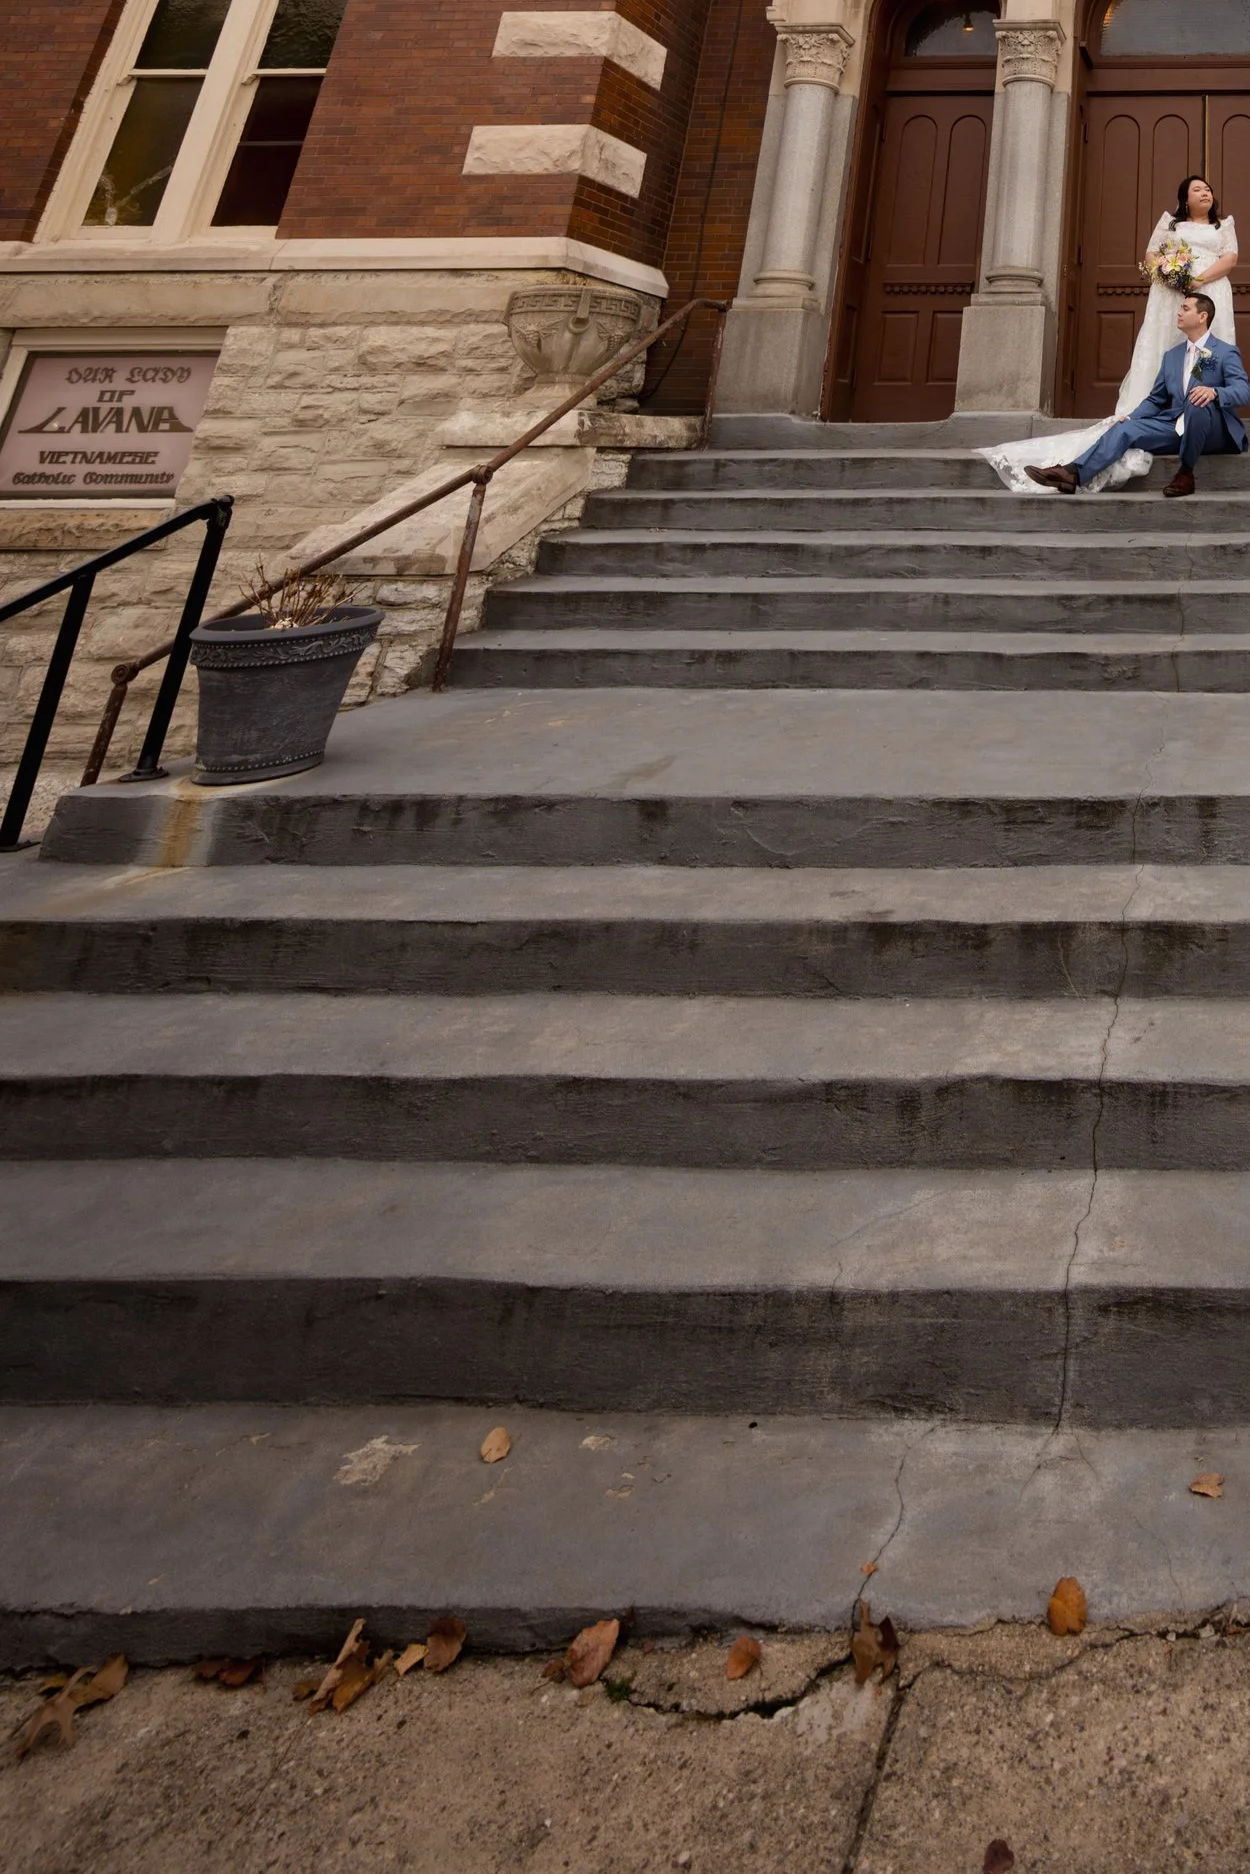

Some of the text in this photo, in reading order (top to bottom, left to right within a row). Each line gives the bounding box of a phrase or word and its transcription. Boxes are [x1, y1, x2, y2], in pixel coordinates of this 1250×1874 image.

[65, 366, 192, 384] OUR LADY
[97, 389, 136, 403] OF
[39, 450, 160, 465] VIETNAMESE
[12, 471, 174, 486] Catholic Community
